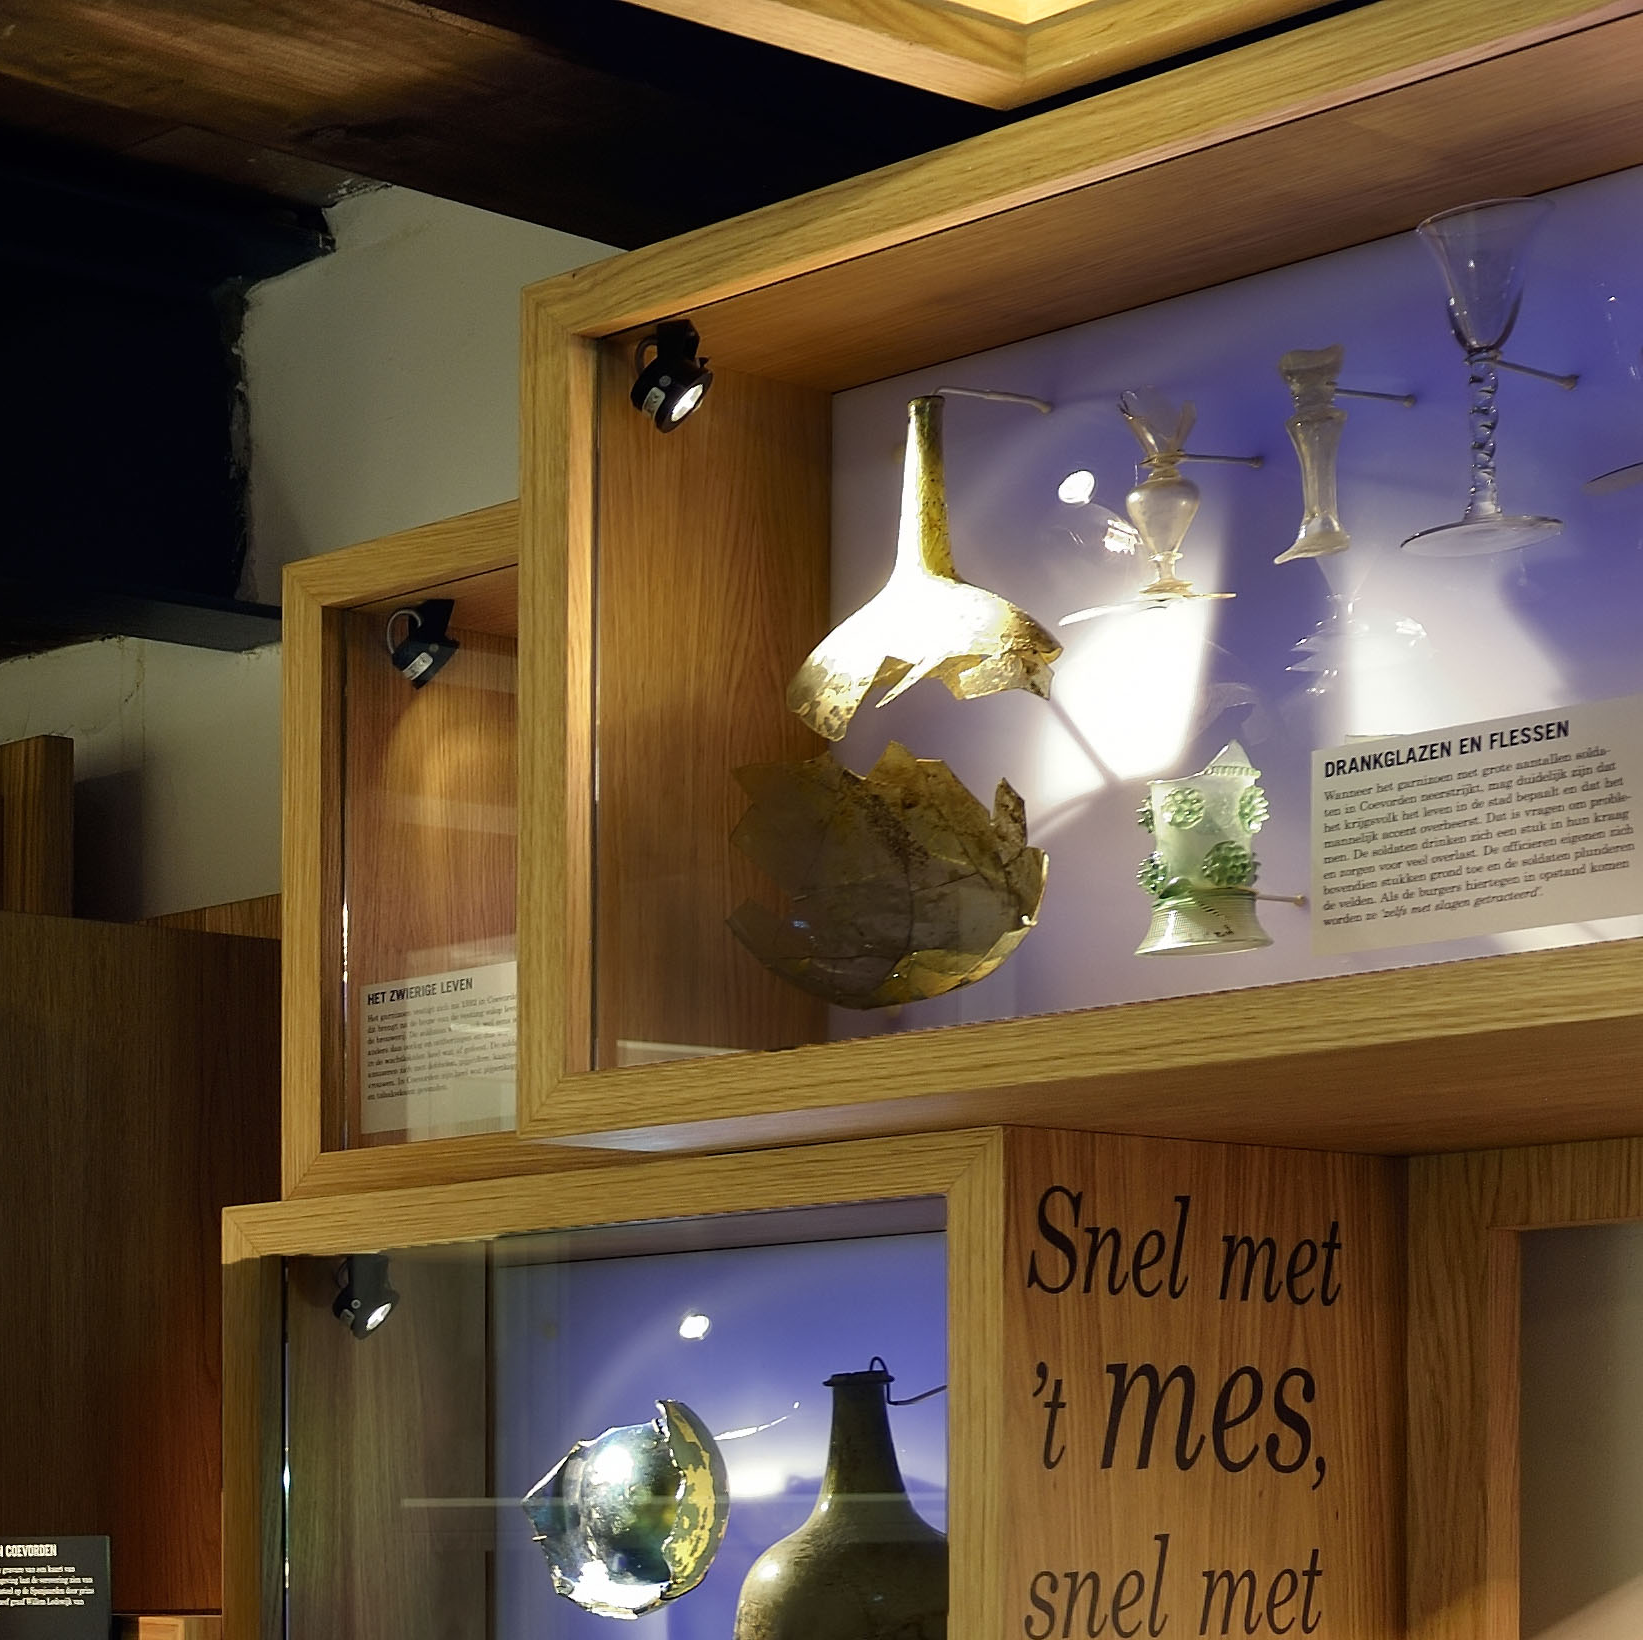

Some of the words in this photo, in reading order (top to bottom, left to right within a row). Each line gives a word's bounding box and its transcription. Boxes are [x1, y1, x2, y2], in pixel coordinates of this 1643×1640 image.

[1324, 740, 1452, 779] DRANKGLAZEN
[1459, 735, 1482, 756] EN
[1489, 719, 1570, 750] FLESSEN
[1345, 804, 1356, 814] in
[1360, 794, 1417, 813] Coevorden
[1488, 779, 1513, 791] mag
[1517, 768, 1568, 786] duidelijk
[1376, 782, 1394, 795] het
[367, 991, 387, 1006] HET
[389, 983, 437, 1002] ZWIERIGE
[440, 977, 473, 994] LEVEN
[1027, 1185, 1191, 1300] Snel
[1219, 1220, 1342, 1307] met
[1100, 1362, 1326, 1491] mes,
[5, 1543, 57, 1557] COEVORDEN
[1024, 1533, 1171, 1640] snel
[1199, 1548, 1323, 1636] met
